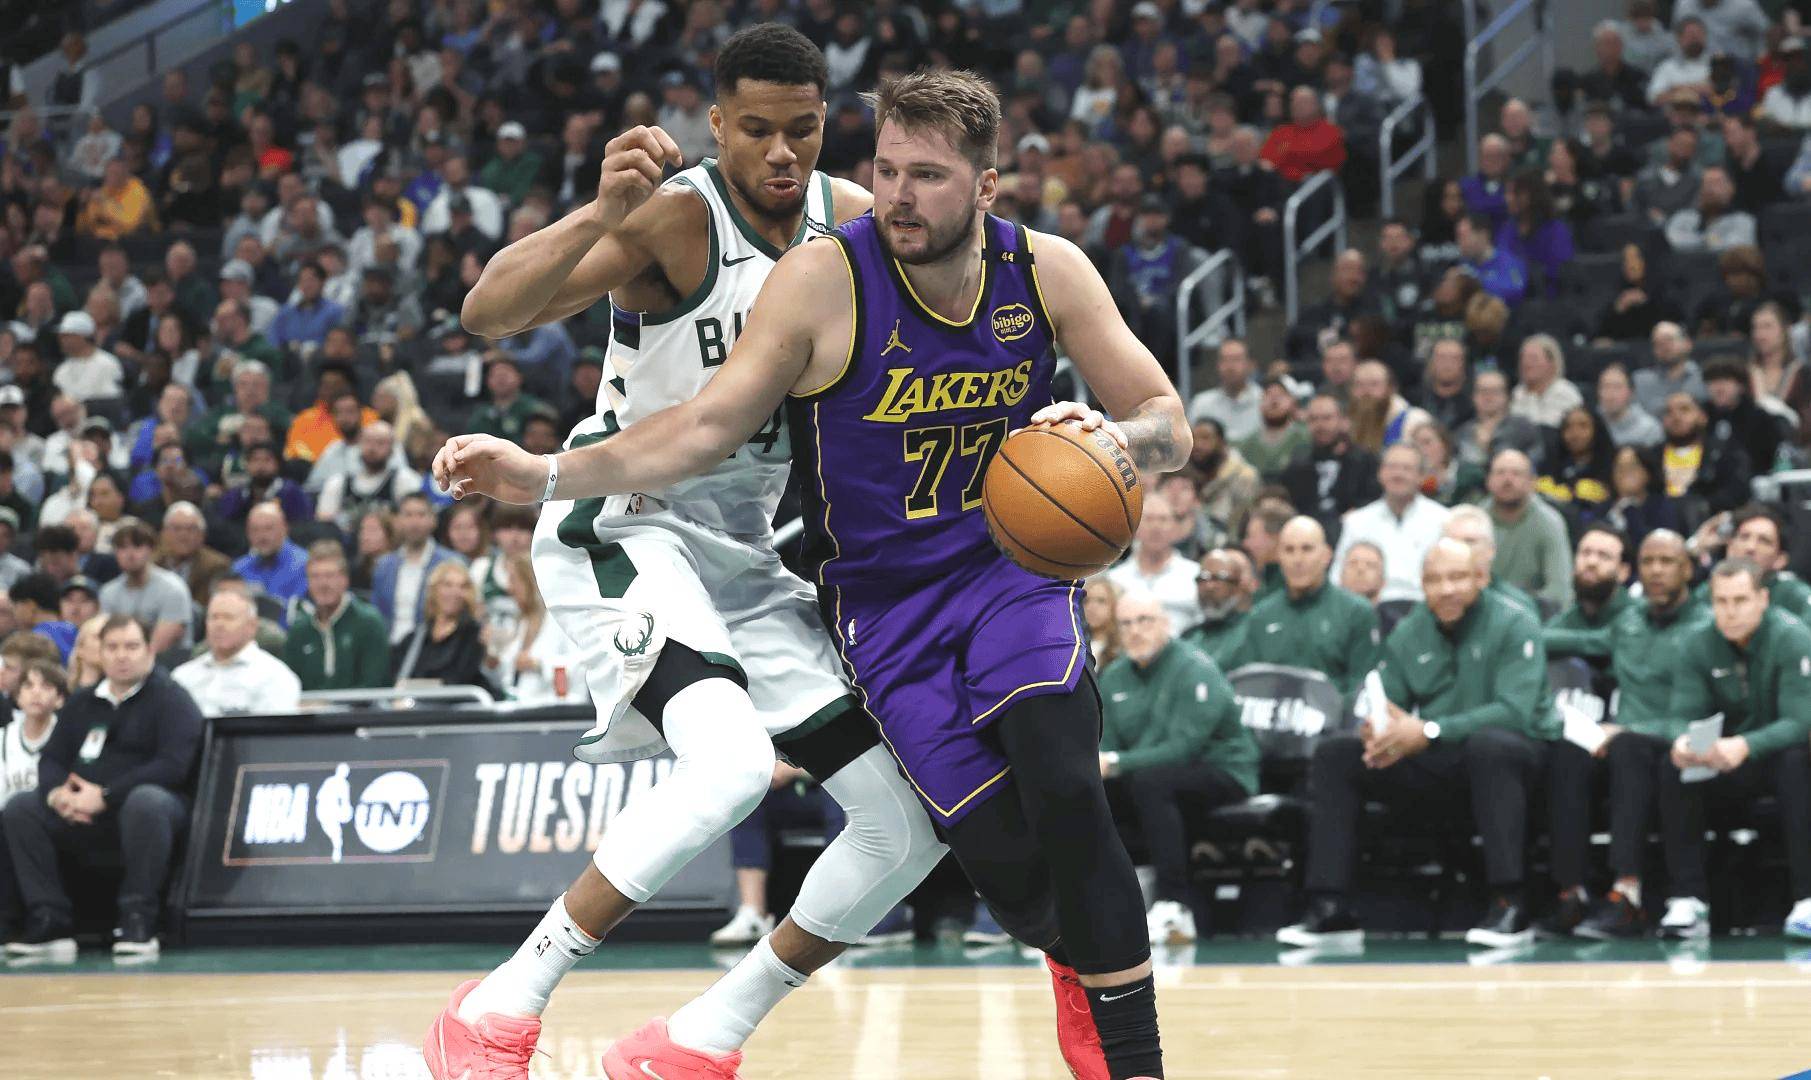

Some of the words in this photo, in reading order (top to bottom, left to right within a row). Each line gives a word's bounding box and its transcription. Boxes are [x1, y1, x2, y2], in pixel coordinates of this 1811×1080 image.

[1001, 251, 1015, 263] 44
[993, 312, 1031, 331] bibigo
[862, 359, 1033, 423] LAKERS
[903, 416, 1009, 520] 77
[243, 782, 310, 844] NBA
